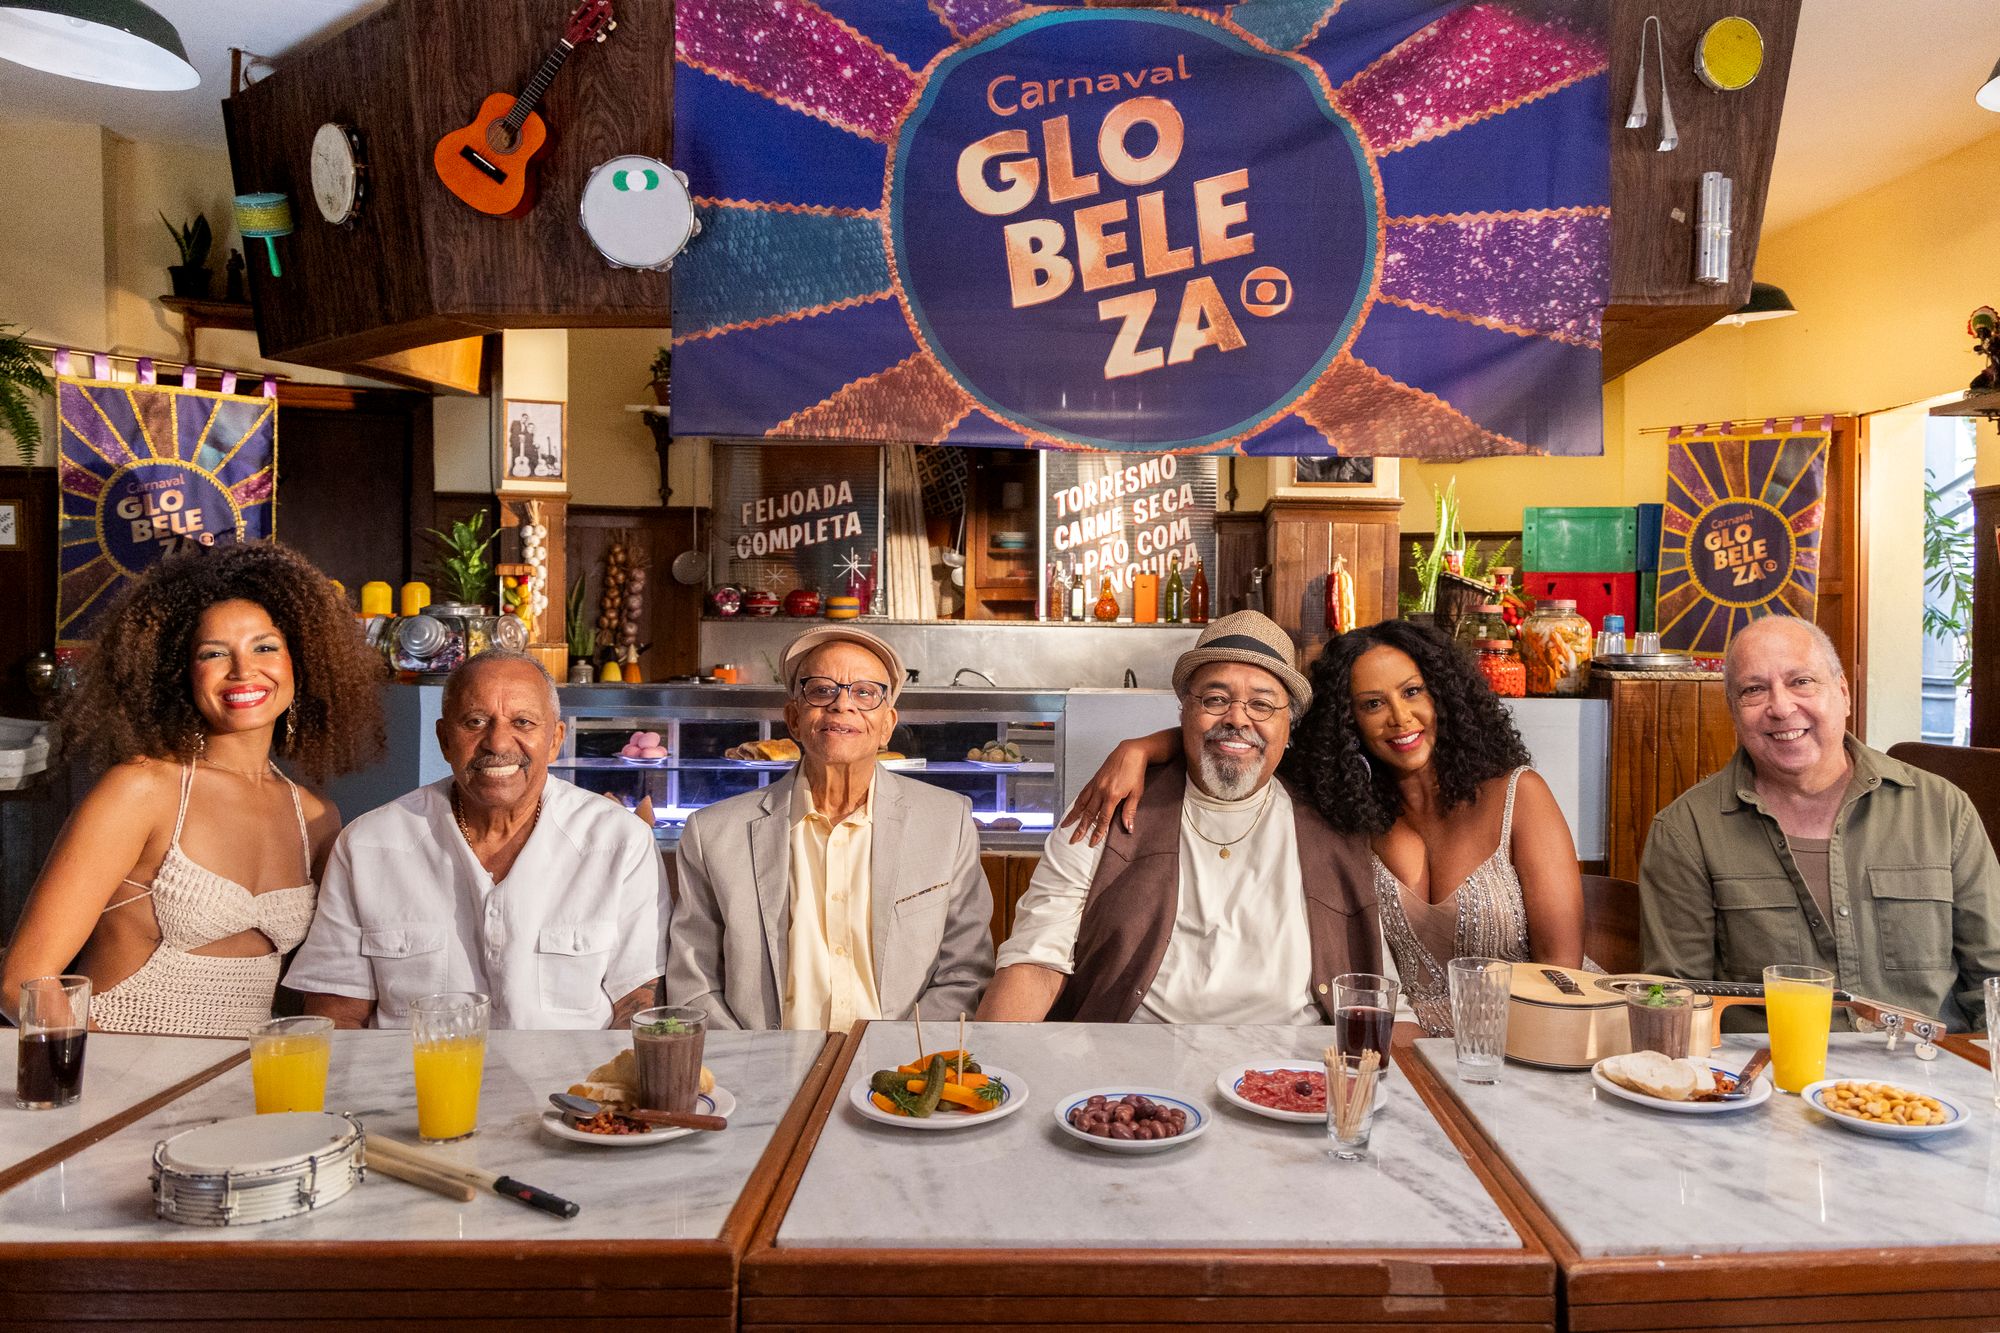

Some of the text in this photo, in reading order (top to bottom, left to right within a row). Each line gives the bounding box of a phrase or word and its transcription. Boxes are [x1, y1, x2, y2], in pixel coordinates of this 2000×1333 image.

[987, 54, 1192, 116] Carnaval
[957, 96, 1184, 216] GLO
[1004, 168, 1254, 309] BELE
[1098, 276, 1247, 380] ZA
[117, 489, 184, 519] GLO
[127, 473, 184, 493] Carnaval
[741, 480, 853, 526] FEIJOADA
[1053, 454, 1177, 518] TORRESMO
[131, 508, 203, 543] BELE
[736, 511, 862, 559] COMPLETA
[1054, 483, 1195, 551] CARNE SECA
[1704, 524, 1752, 551] GLO
[1711, 510, 1754, 530] Carnaval
[1084, 517, 1192, 576] PÃO COM
[1714, 538, 1768, 571] BELE
[1732, 562, 1766, 586] ZA
